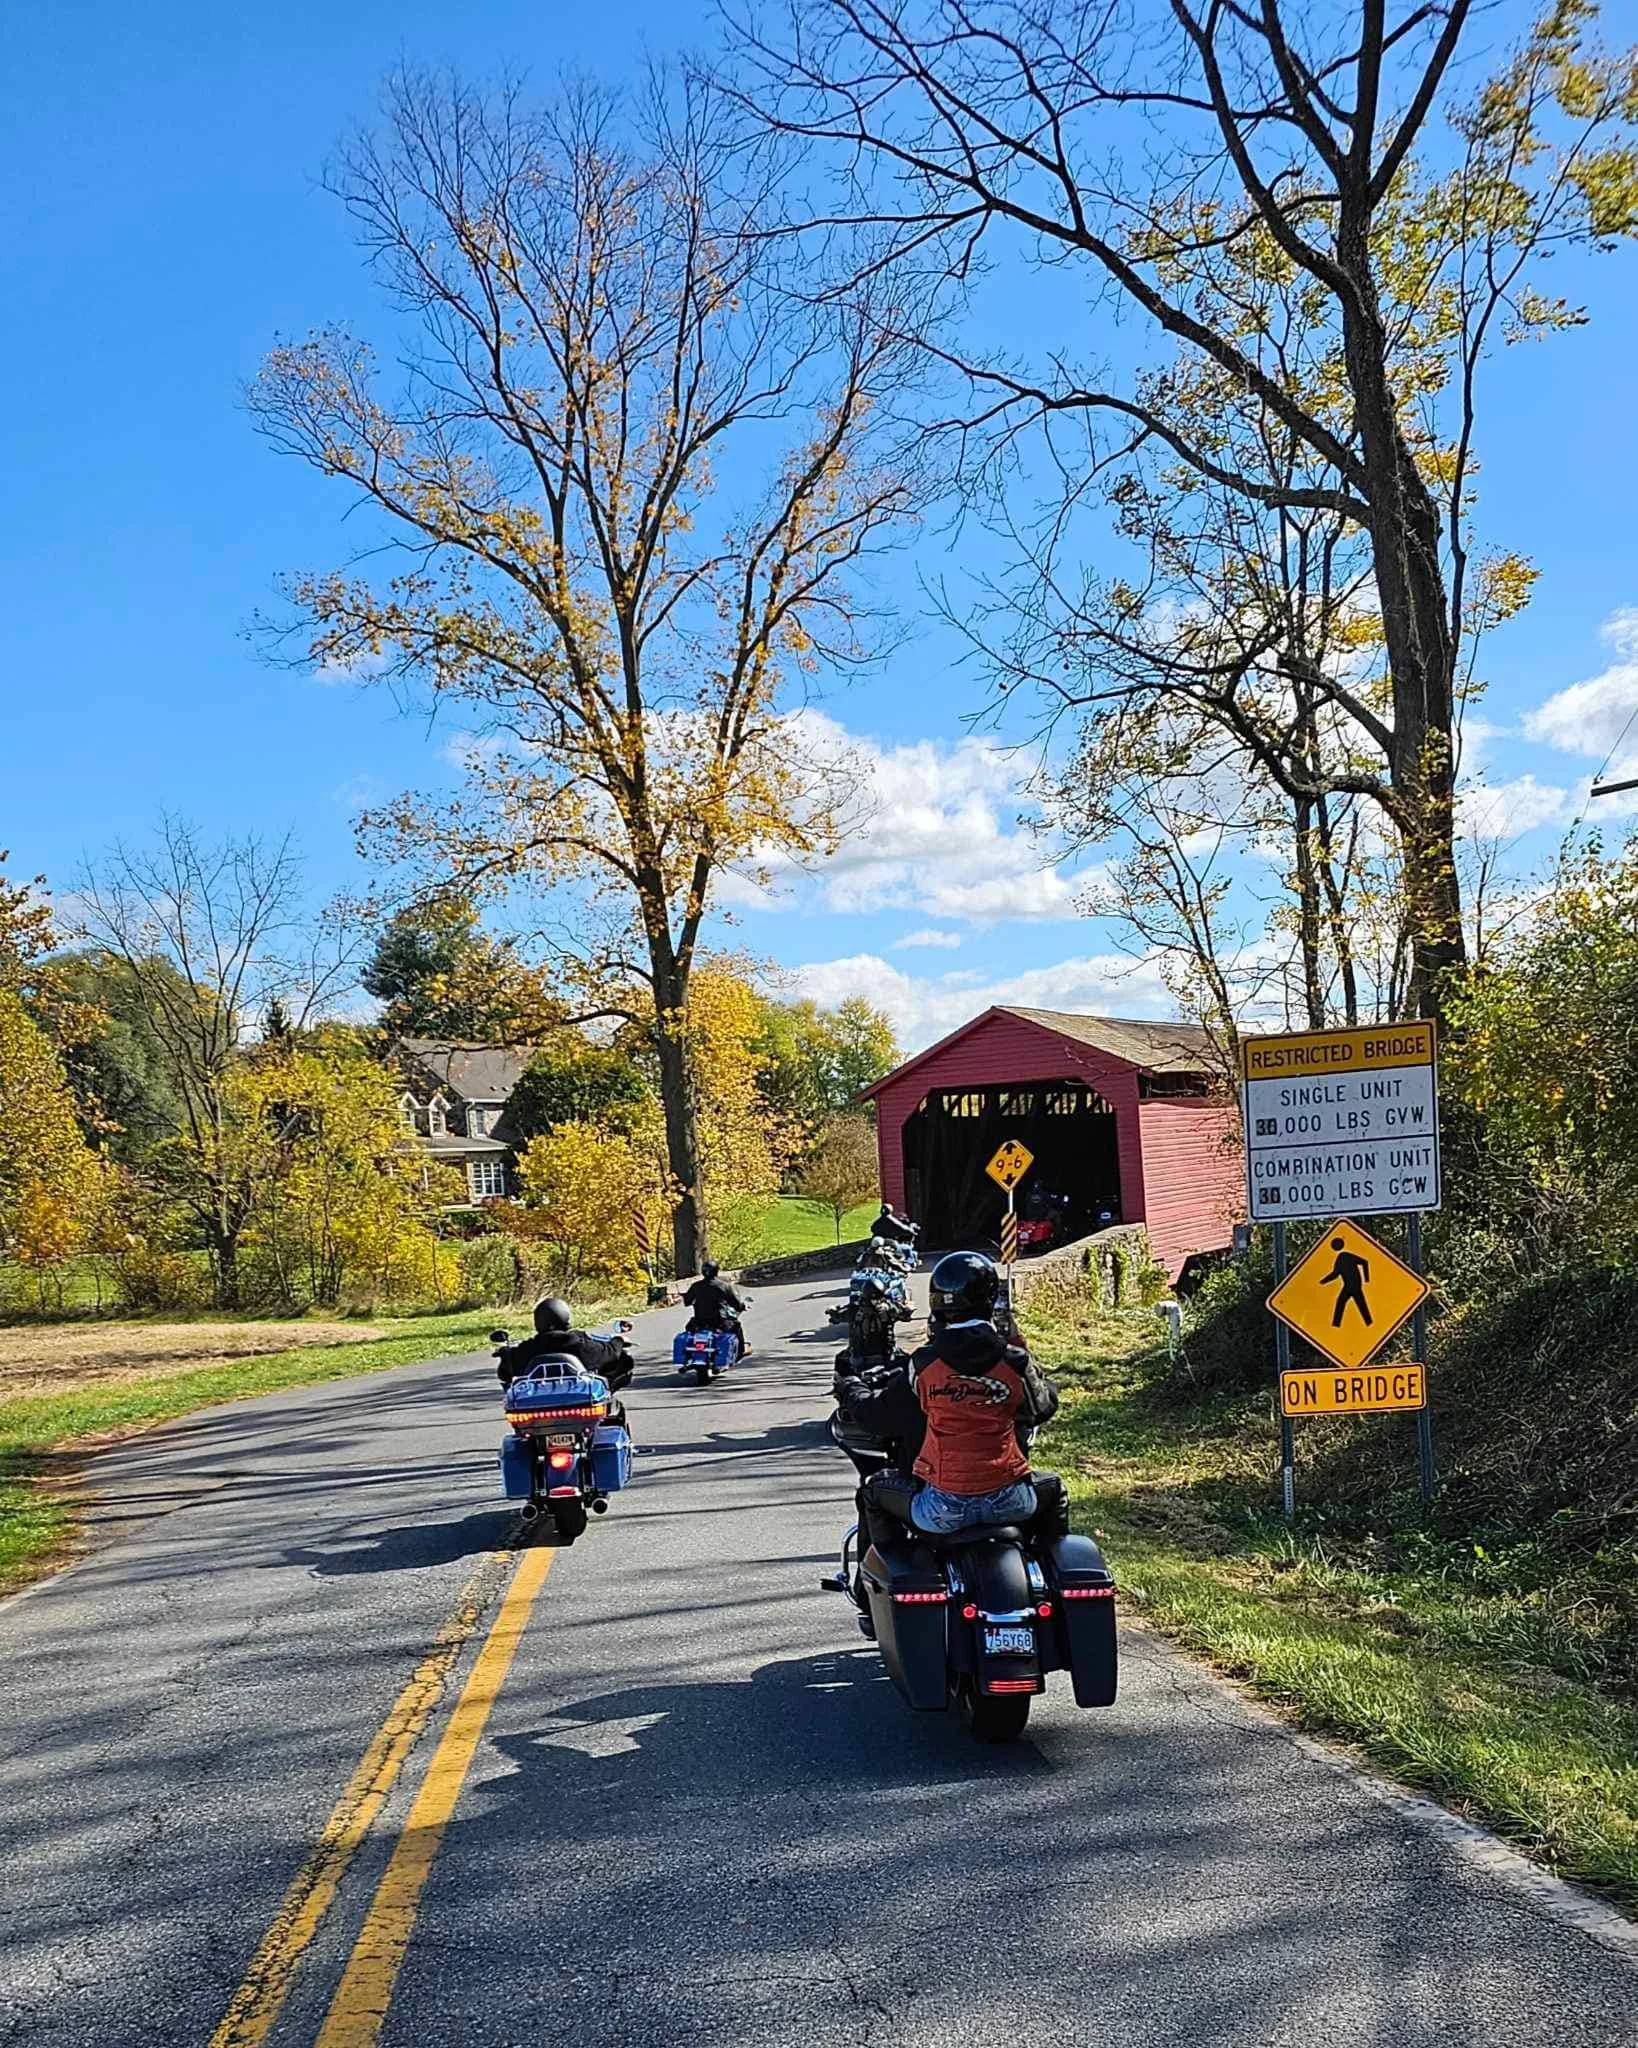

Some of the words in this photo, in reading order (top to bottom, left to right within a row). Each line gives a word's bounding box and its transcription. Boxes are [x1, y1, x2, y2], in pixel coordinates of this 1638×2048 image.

[1251, 1043, 1353, 1069] RESTRICTED
[1364, 1036, 1425, 1059] BRIDGE
[1280, 1085, 1346, 1106] SINGLE
[1361, 1079, 1402, 1099] UNIT
[1336, 1110, 1370, 1130] LBS
[1385, 1106, 1424, 1125] GVW
[1254, 1153, 1376, 1178] COMBINATION
[1390, 1148, 1431, 1168] UNIT
[1339, 1180, 1374, 1199] LBS
[1389, 1176, 1427, 1195] GCW
[1287, 1379, 1317, 1406] ON
[1334, 1373, 1419, 1404] BRIDGE
